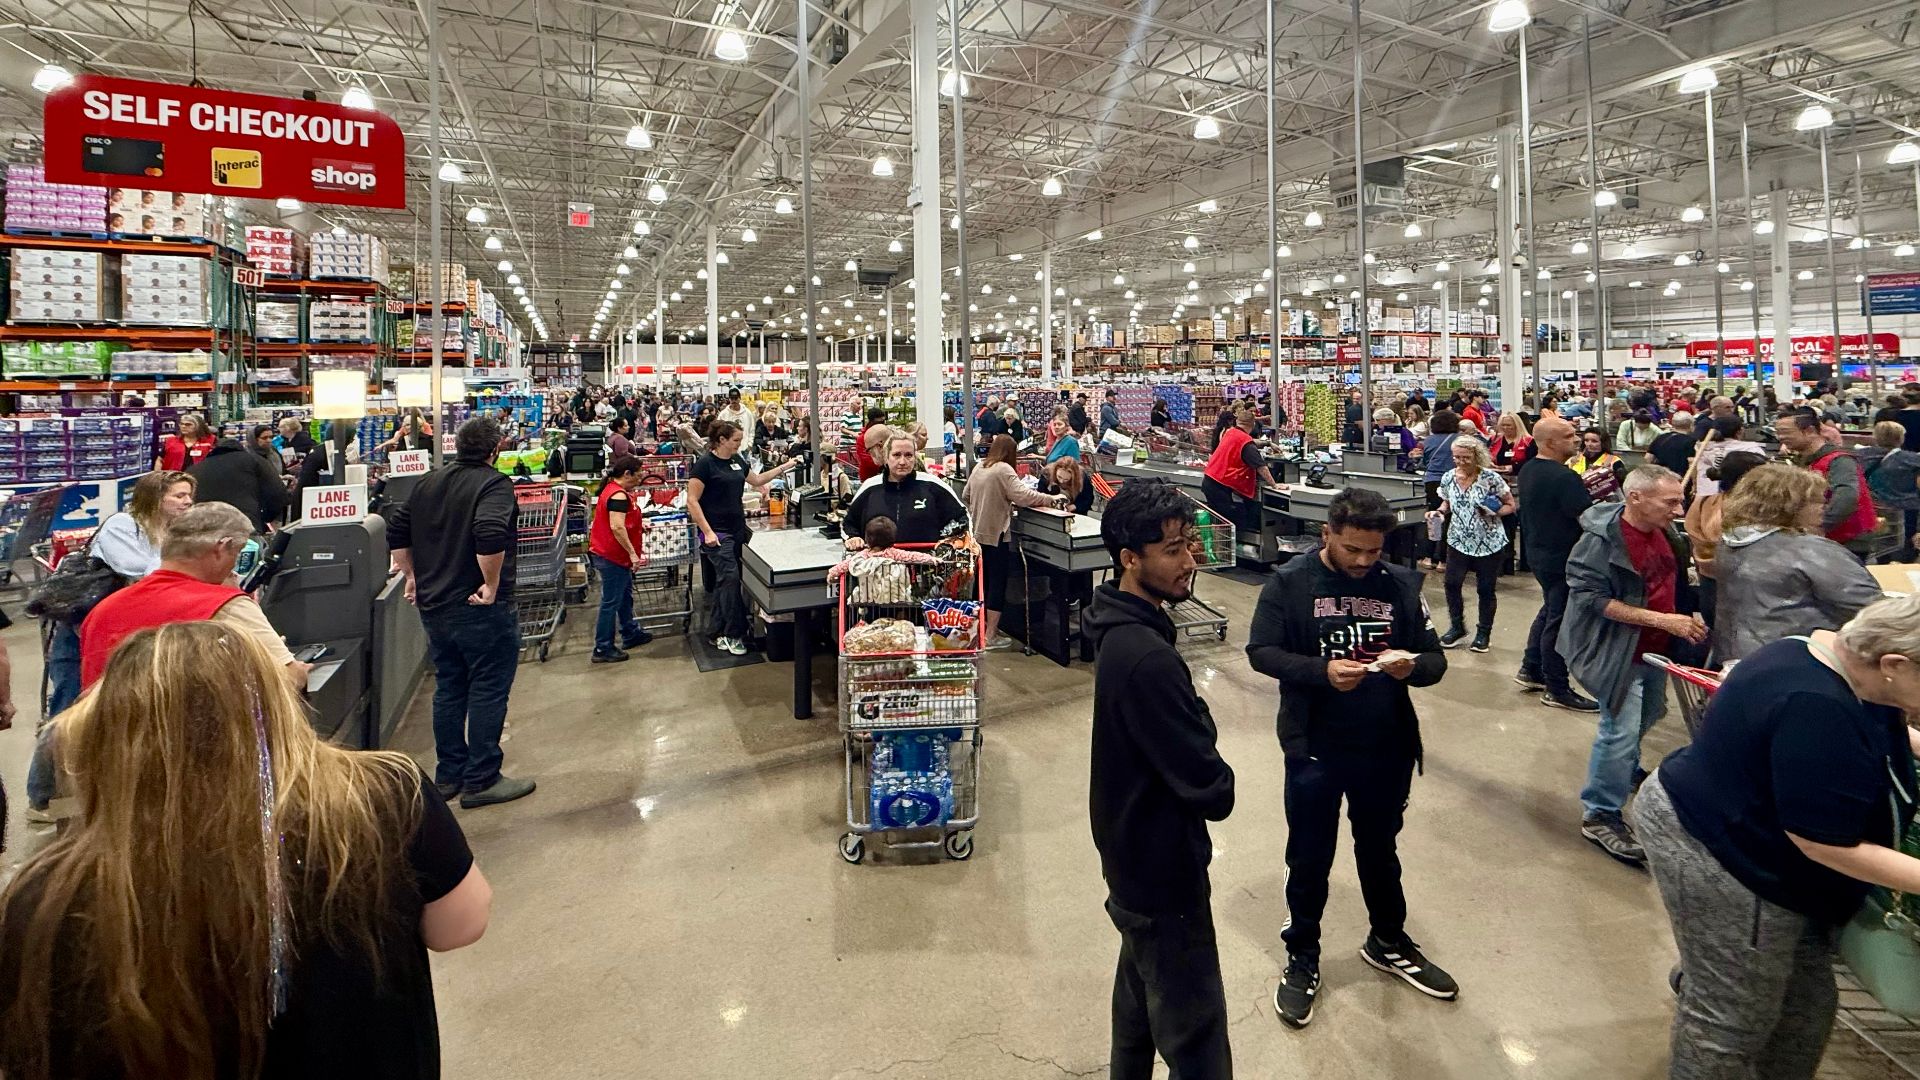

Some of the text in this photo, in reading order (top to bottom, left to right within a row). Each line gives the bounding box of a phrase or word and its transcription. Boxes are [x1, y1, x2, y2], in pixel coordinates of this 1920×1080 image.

[83, 90, 375, 148] SELF CHECKOUT
[214, 159, 260, 172] Interac
[311, 165, 377, 190] shop
[237, 269, 262, 285] 501
[387, 300, 403, 312] 503
[400, 453, 420, 462] LANE
[396, 463, 425, 473] CLOSED
[318, 490, 350, 503] LANE
[310, 504, 356, 519] CLOSED
[925, 607, 975, 630] Ruffles
[882, 694, 920, 709] ZERO
